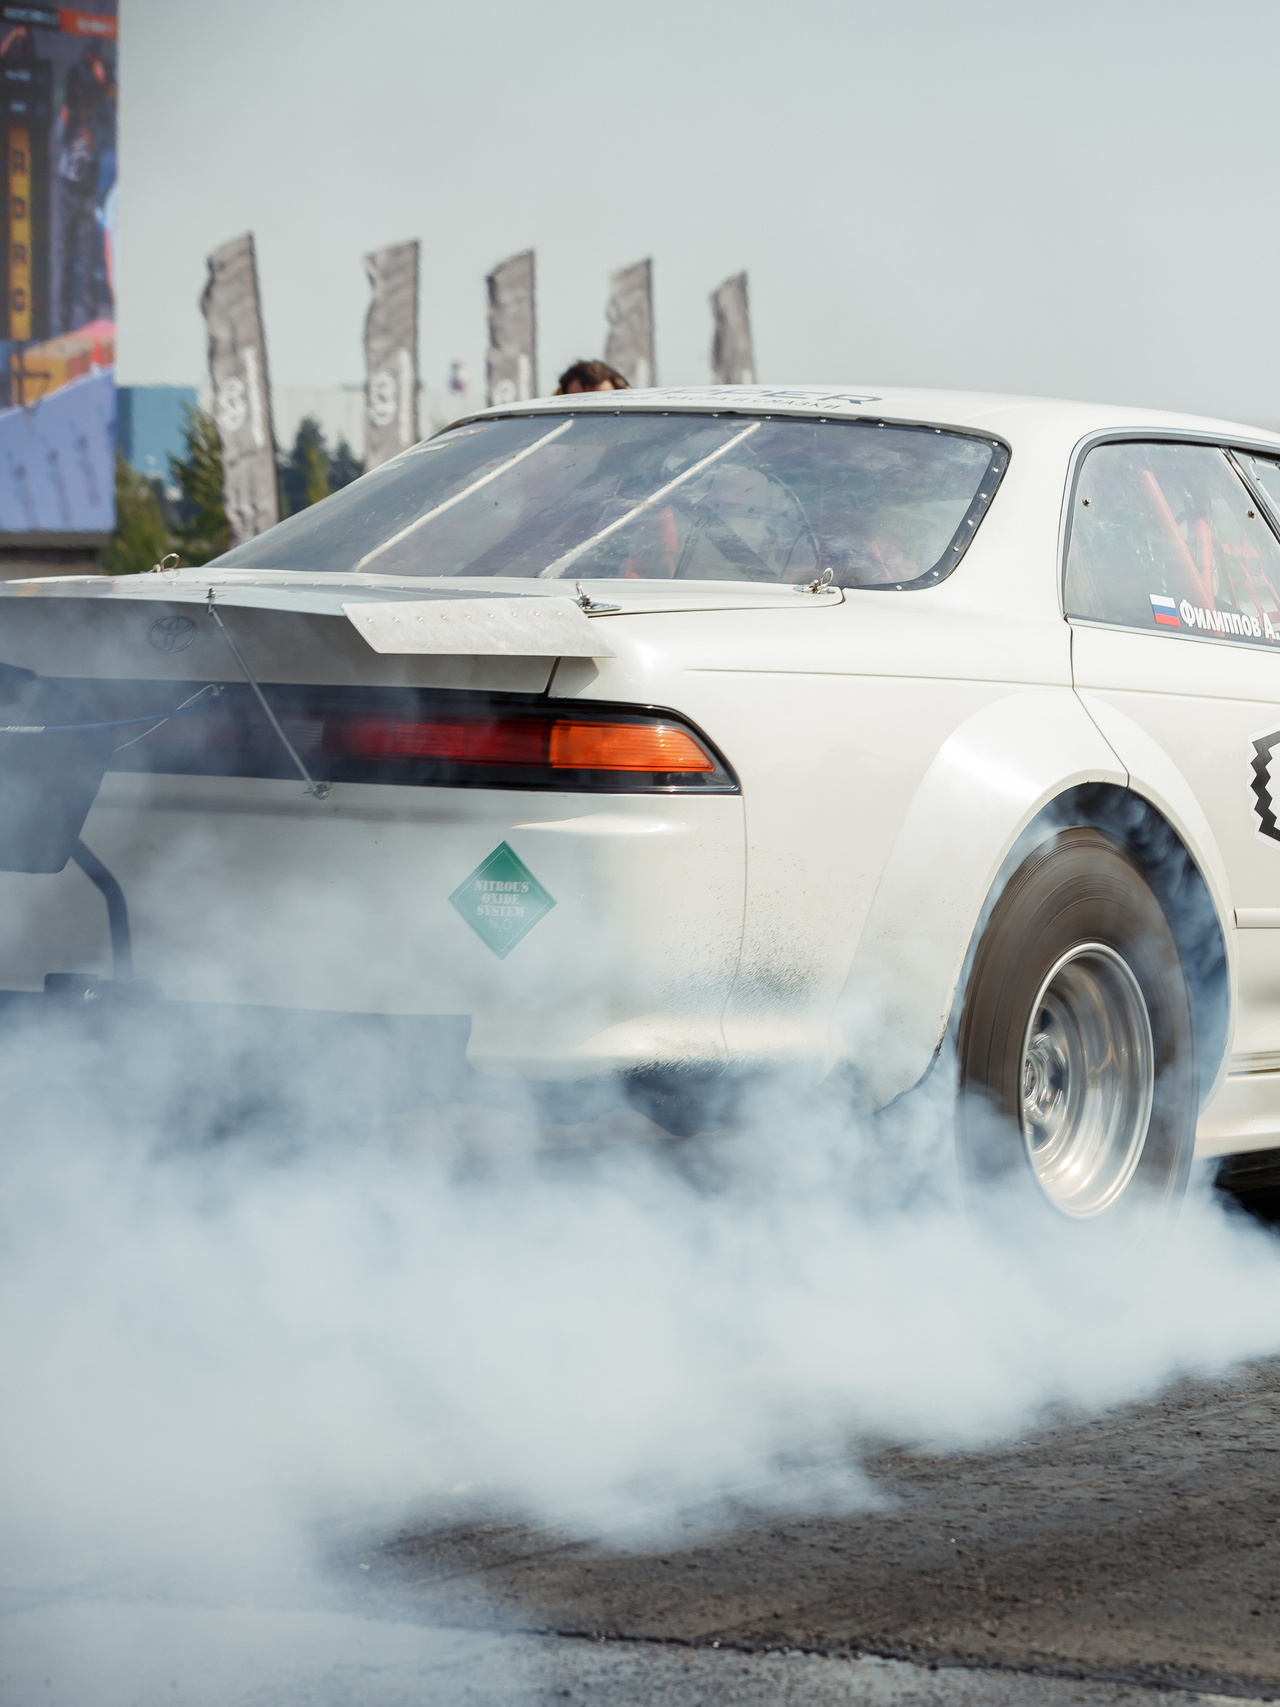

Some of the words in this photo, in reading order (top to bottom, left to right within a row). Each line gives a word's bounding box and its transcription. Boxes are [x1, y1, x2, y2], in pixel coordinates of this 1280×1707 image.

[752, 398, 841, 410] СМАЗКИ
[474, 880, 529, 893] NITROUS
[481, 892, 520, 905] OXIDE
[476, 904, 525, 917] SYSTEM
